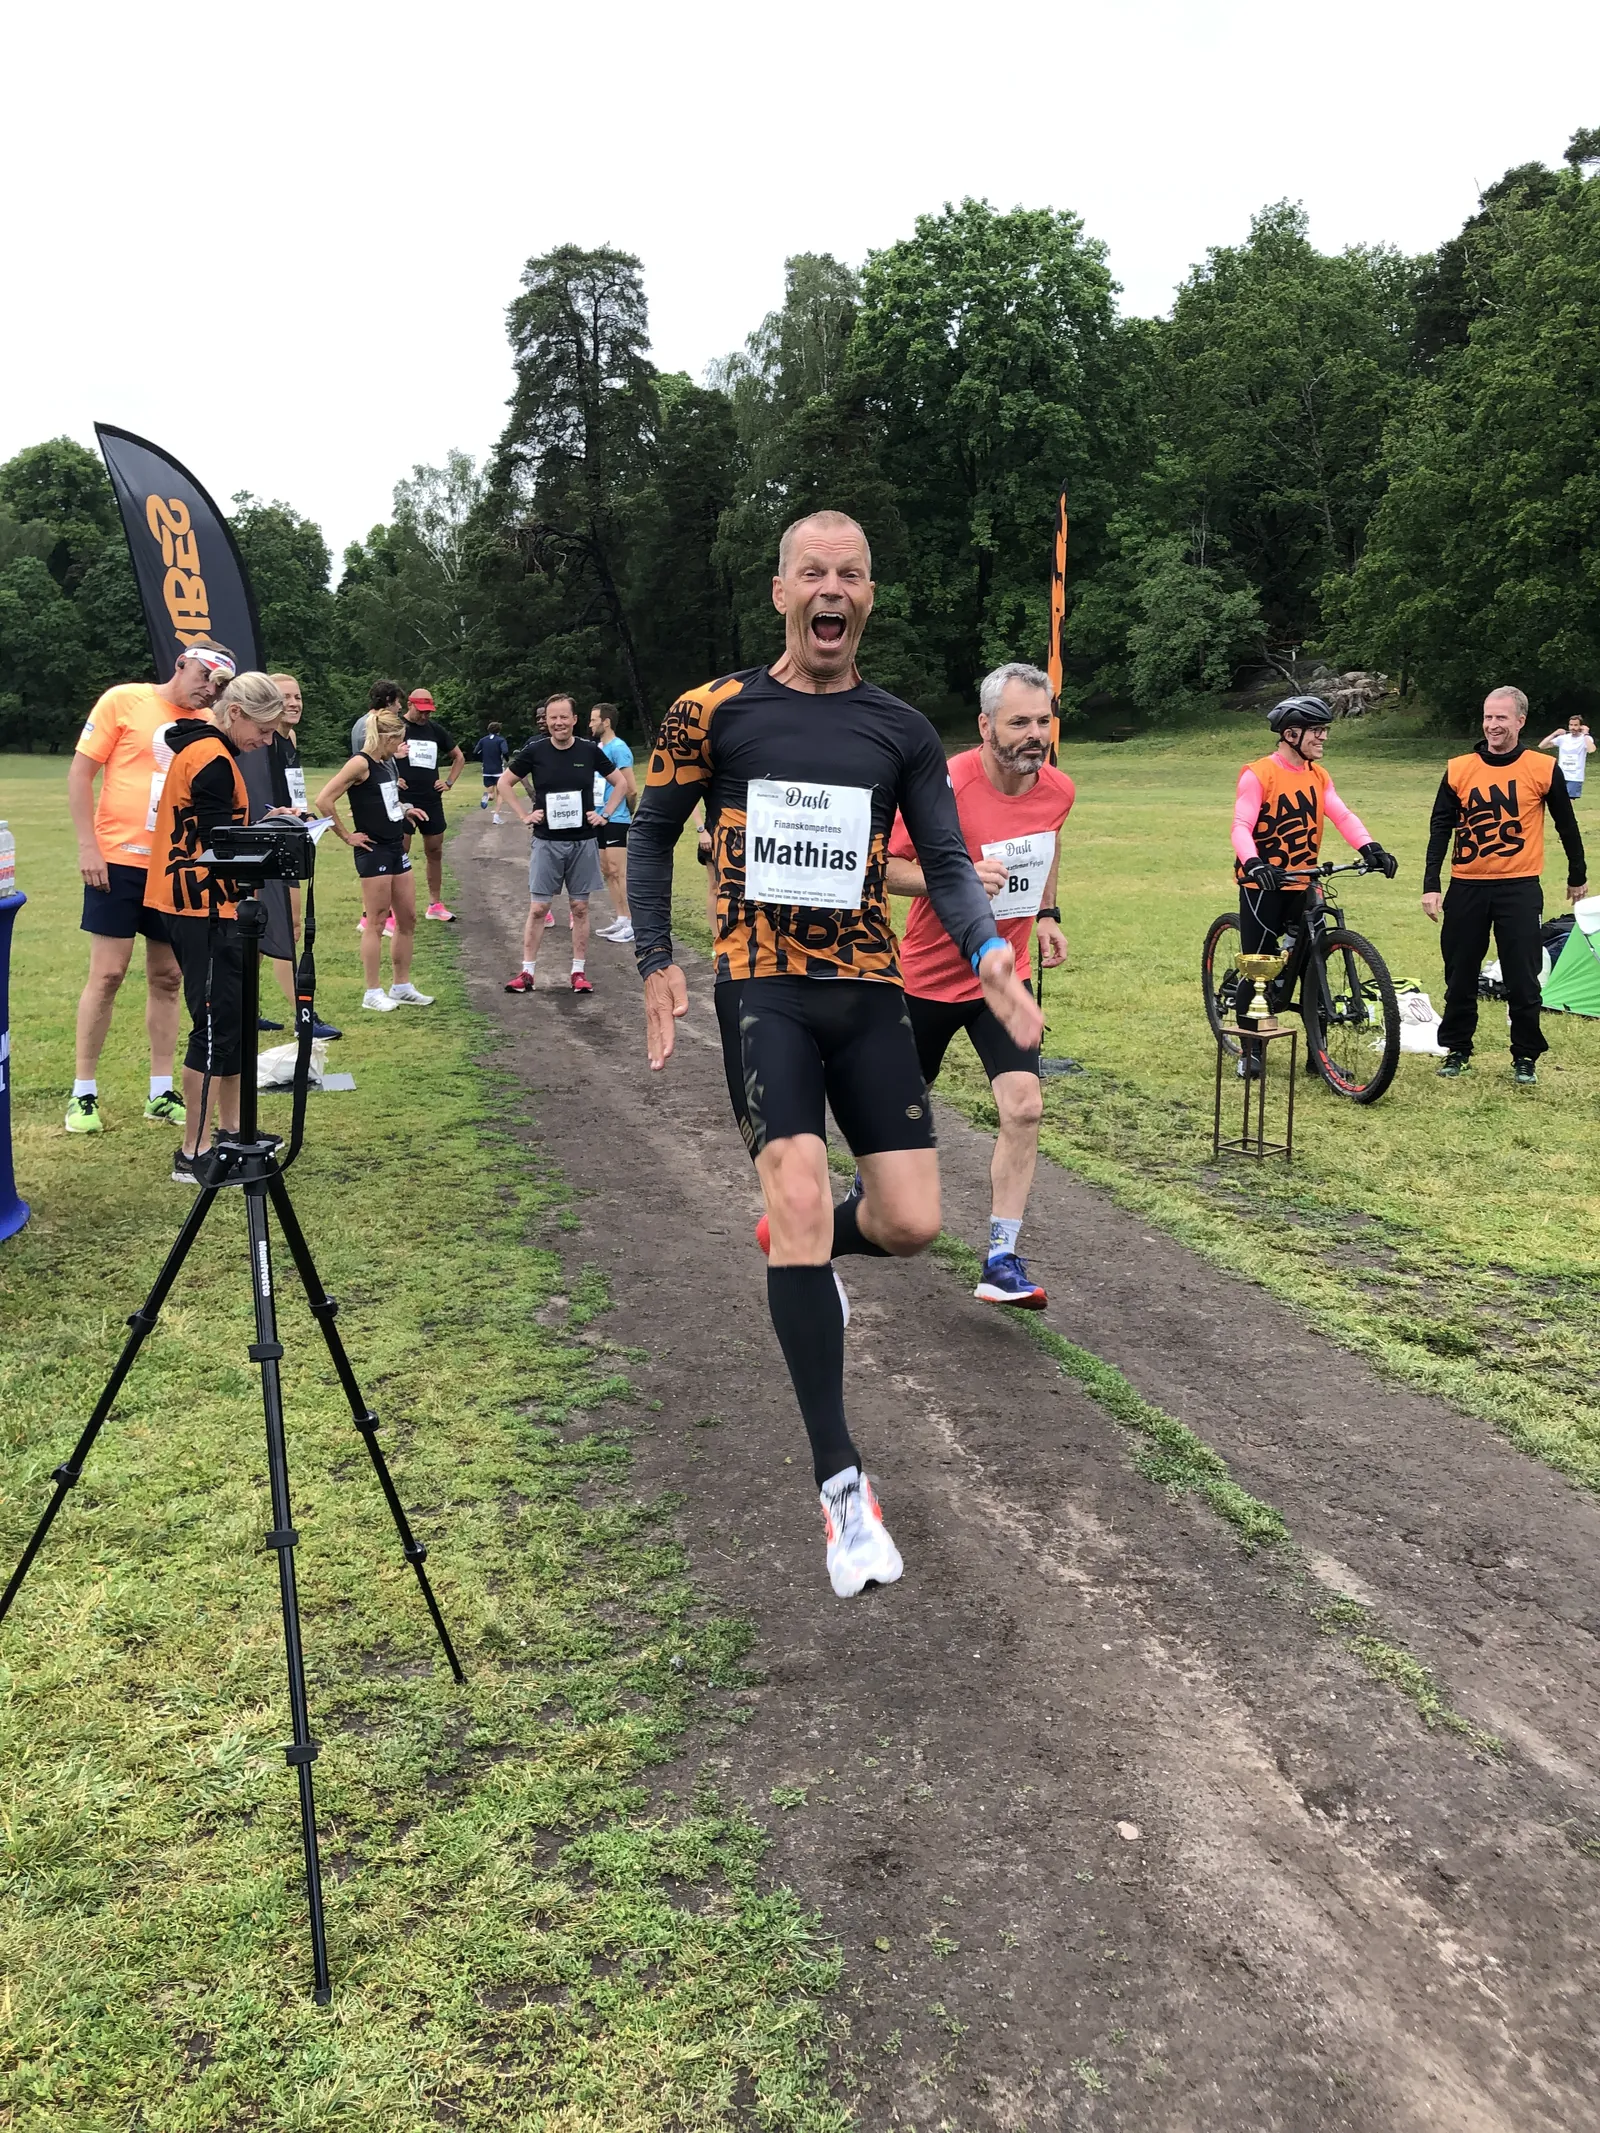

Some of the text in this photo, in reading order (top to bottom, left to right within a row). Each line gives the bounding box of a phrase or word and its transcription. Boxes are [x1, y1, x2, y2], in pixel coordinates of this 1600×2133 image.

[785, 786, 832, 809] Dash
[552, 809, 579, 819] Jesper
[774, 819, 842, 834] Finanskompetens
[754, 836, 858, 872] Mathias
[1005, 840, 1032, 857] Dash
[1008, 875, 1029, 893] Bo
[258, 1240, 271, 1297] Manfrotto
